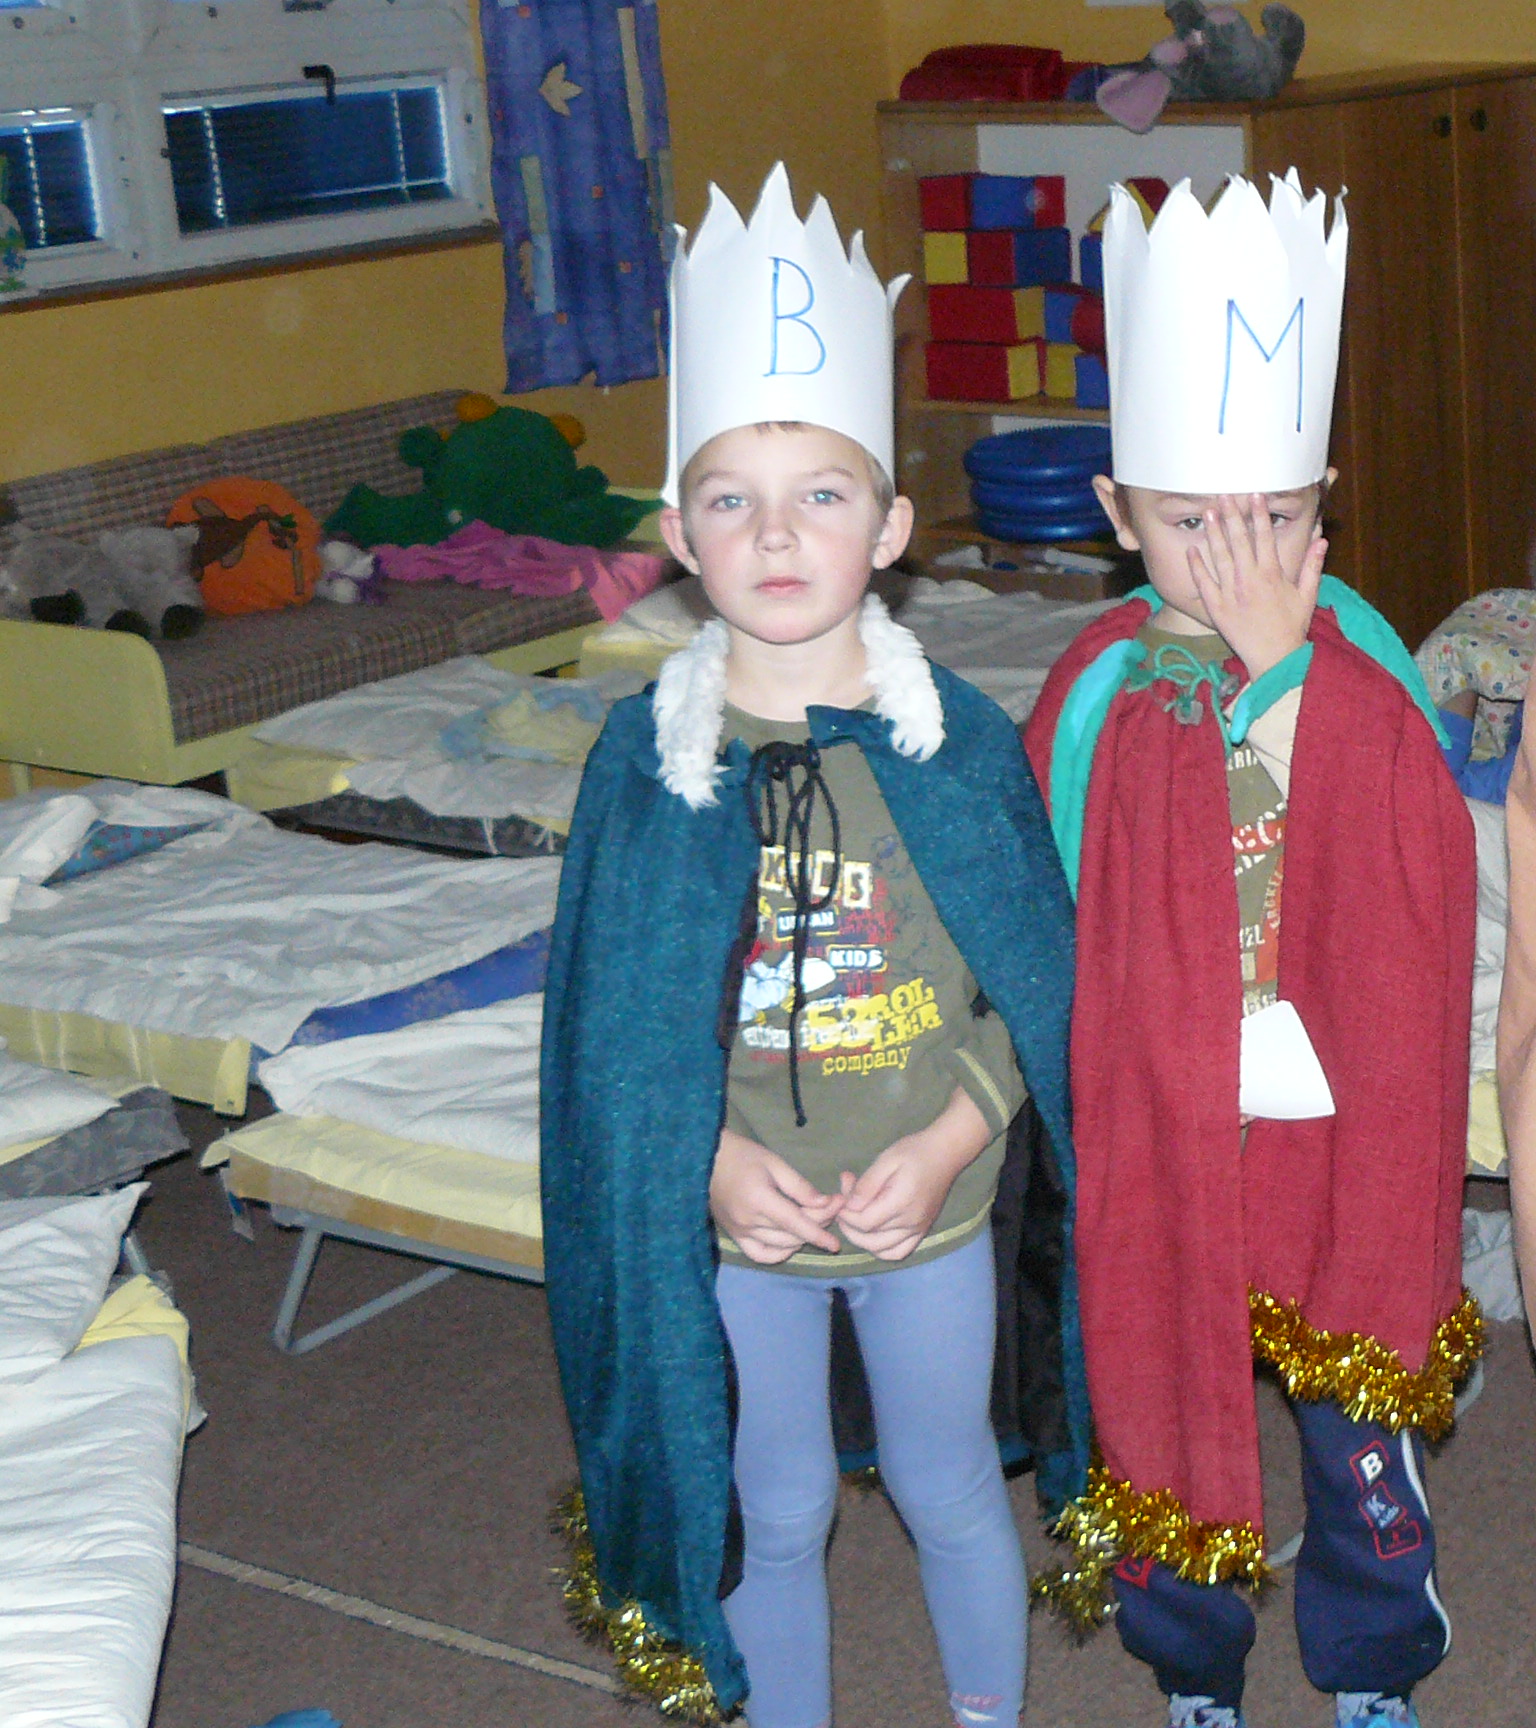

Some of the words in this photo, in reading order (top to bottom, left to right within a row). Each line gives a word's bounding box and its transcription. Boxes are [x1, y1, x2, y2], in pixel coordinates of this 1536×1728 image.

[762, 255, 827, 378] B
[1218, 296, 1304, 435] M
[829, 948, 884, 968] KIDS
[822, 1046, 913, 1077] company
[1360, 1451, 1384, 1484] B
